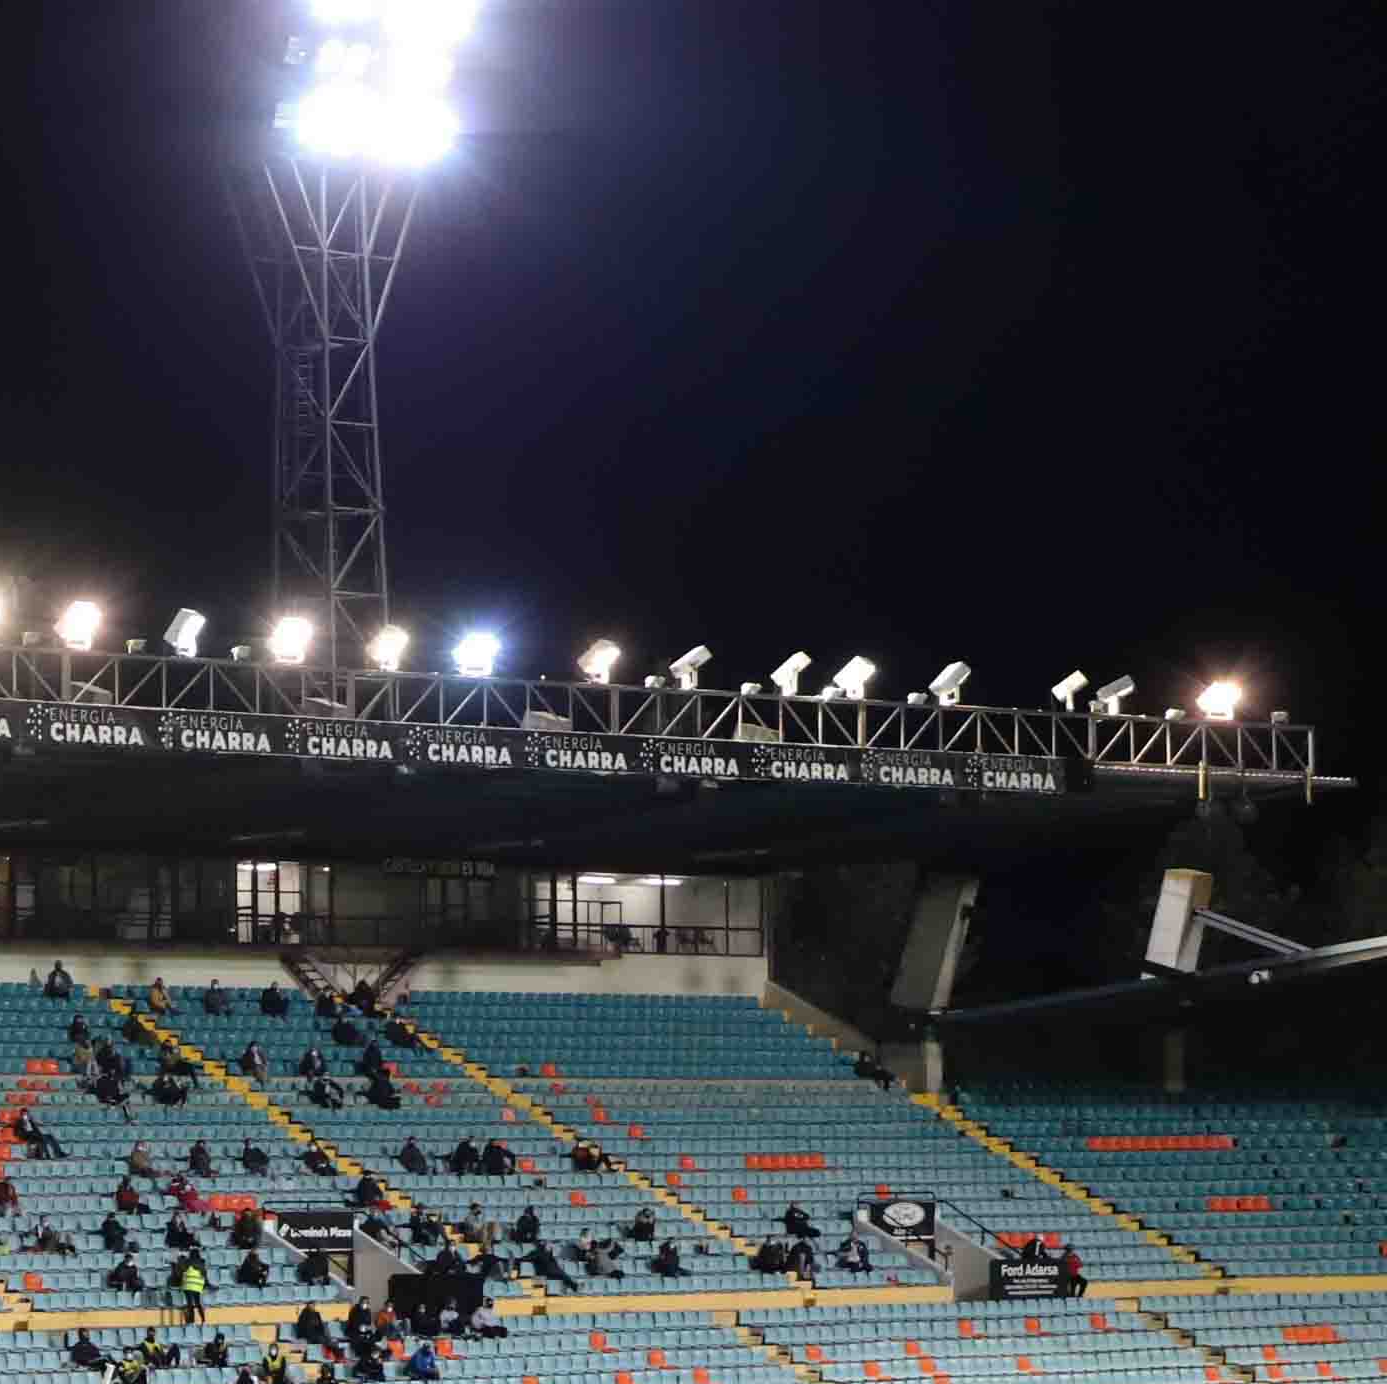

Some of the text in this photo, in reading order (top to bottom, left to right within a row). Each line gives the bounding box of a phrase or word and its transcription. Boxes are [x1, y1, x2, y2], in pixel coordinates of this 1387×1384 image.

[180, 714, 243, 731] ENERGÍA
[307, 722, 368, 738] ENERGÍA
[50, 723, 144, 745] CHARRA
[181, 729, 271, 752] CHARRA
[427, 729, 486, 744] ENERGÍA
[545, 736, 603, 751] ENERGÍA
[307, 736, 393, 759] CHARRA
[428, 743, 511, 765] CHARRA
[545, 749, 627, 769] CHARRA
[660, 754, 739, 776] CHARRA
[771, 760, 848, 781] CHARRA
[880, 765, 954, 785] CHARRA
[983, 770, 1055, 790] CHARRA
[1001, 1264, 1060, 1277] Ford Adarsa
